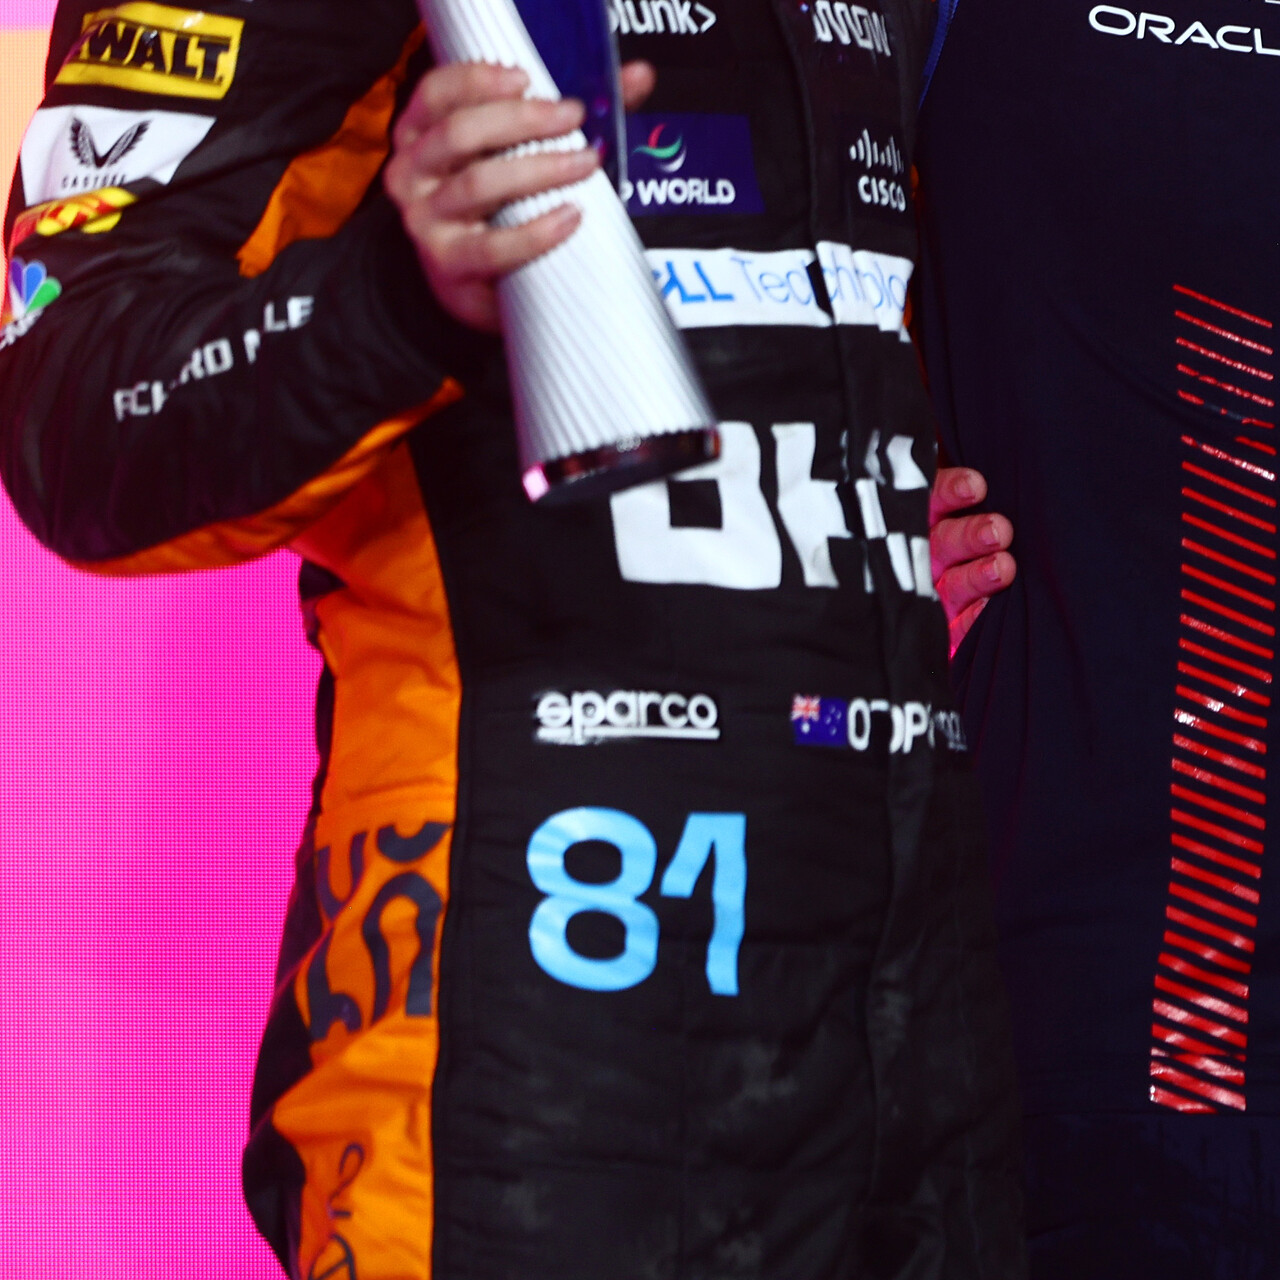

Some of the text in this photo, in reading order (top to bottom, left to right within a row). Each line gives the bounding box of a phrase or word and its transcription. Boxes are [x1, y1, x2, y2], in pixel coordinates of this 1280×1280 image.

[636, 179, 735, 205] WORLD
[536, 691, 720, 744] sparco
[527, 806, 746, 996] 81
